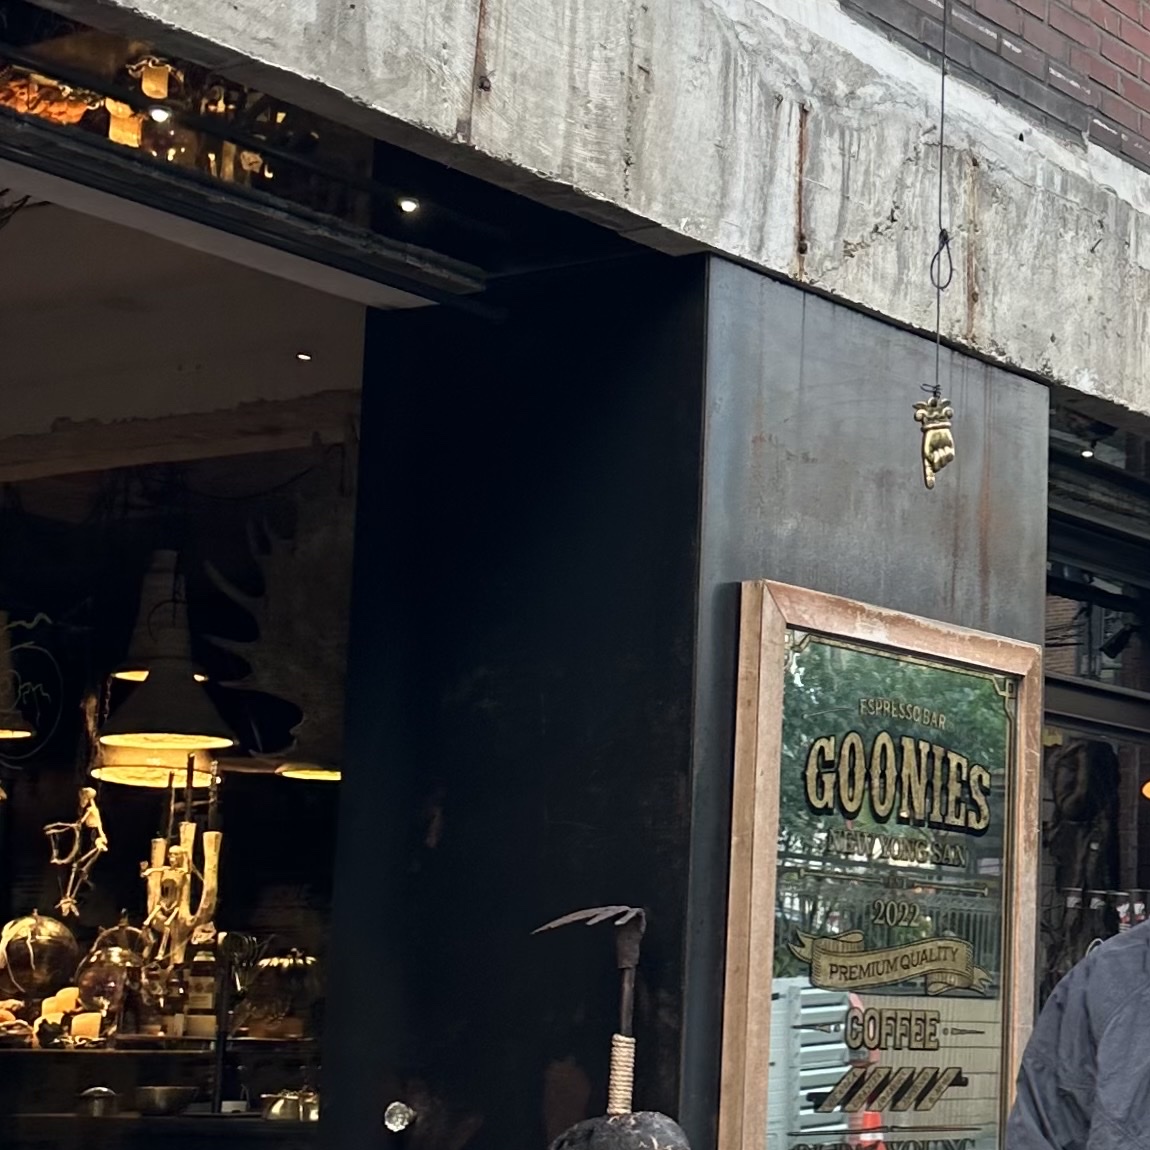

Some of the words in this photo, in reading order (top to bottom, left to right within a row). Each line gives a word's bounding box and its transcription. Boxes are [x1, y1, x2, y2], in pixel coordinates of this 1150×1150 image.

[858, 697, 921, 722] ESPRESSO
[922, 707, 946, 730] BAR
[804, 731, 992, 837] GOONIES
[827, 828, 874, 856] NEW
[877, 836, 929, 864] YONG
[930, 840, 969, 868] SAN
[872, 899, 921, 928] 2022
[829, 957, 898, 982] PREMIUM
[899, 945, 960, 970] QUALITY
[844, 1008, 941, 1051] COFFEE
